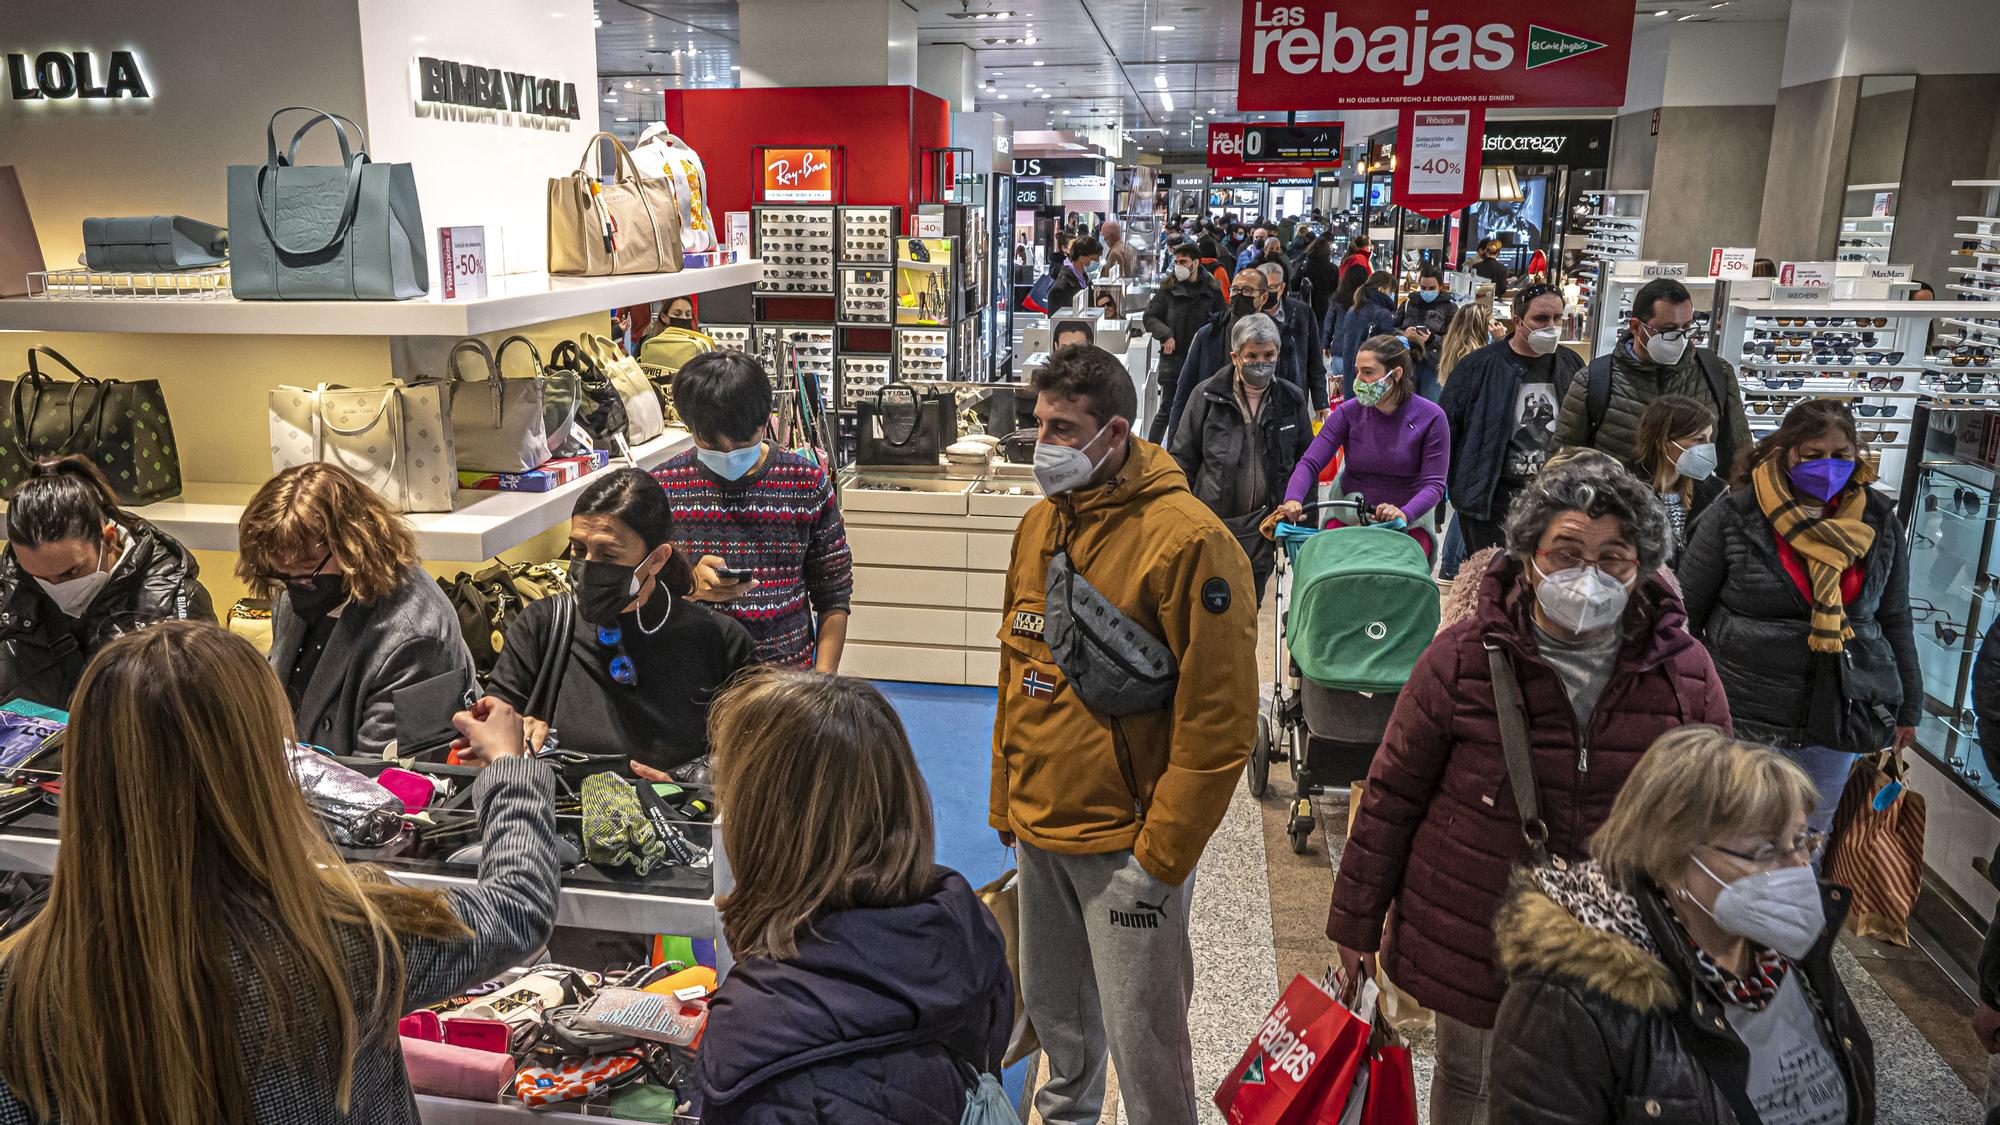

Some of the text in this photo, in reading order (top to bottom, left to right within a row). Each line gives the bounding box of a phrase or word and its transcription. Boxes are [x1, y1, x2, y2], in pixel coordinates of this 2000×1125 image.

[1254, 1, 1306, 27] Las
[1252, 9, 1515, 86] rebajas
[1531, 38, 1588, 53] El Corte Inglés
[7, 51, 150, 99] LOLA
[418, 56, 581, 121] BIMBA Y LOLA
[1246, 131, 1262, 155] 0
[1481, 134, 1567, 153] istocrazy
[1012, 159, 1041, 176] US
[1413, 158, 1461, 175] -40%
[456, 253, 484, 276] -50%
[1647, 266, 1683, 276] GUESS
[1723, 260, 1749, 270] -50%
[1871, 270, 1905, 278] MaxMara
[1786, 291, 1818, 299] SKECHERS
[1080, 596, 1164, 671] JORDAN
[1109, 908, 1159, 928] PUMA
[1257, 1014, 1316, 1083] rebajas
